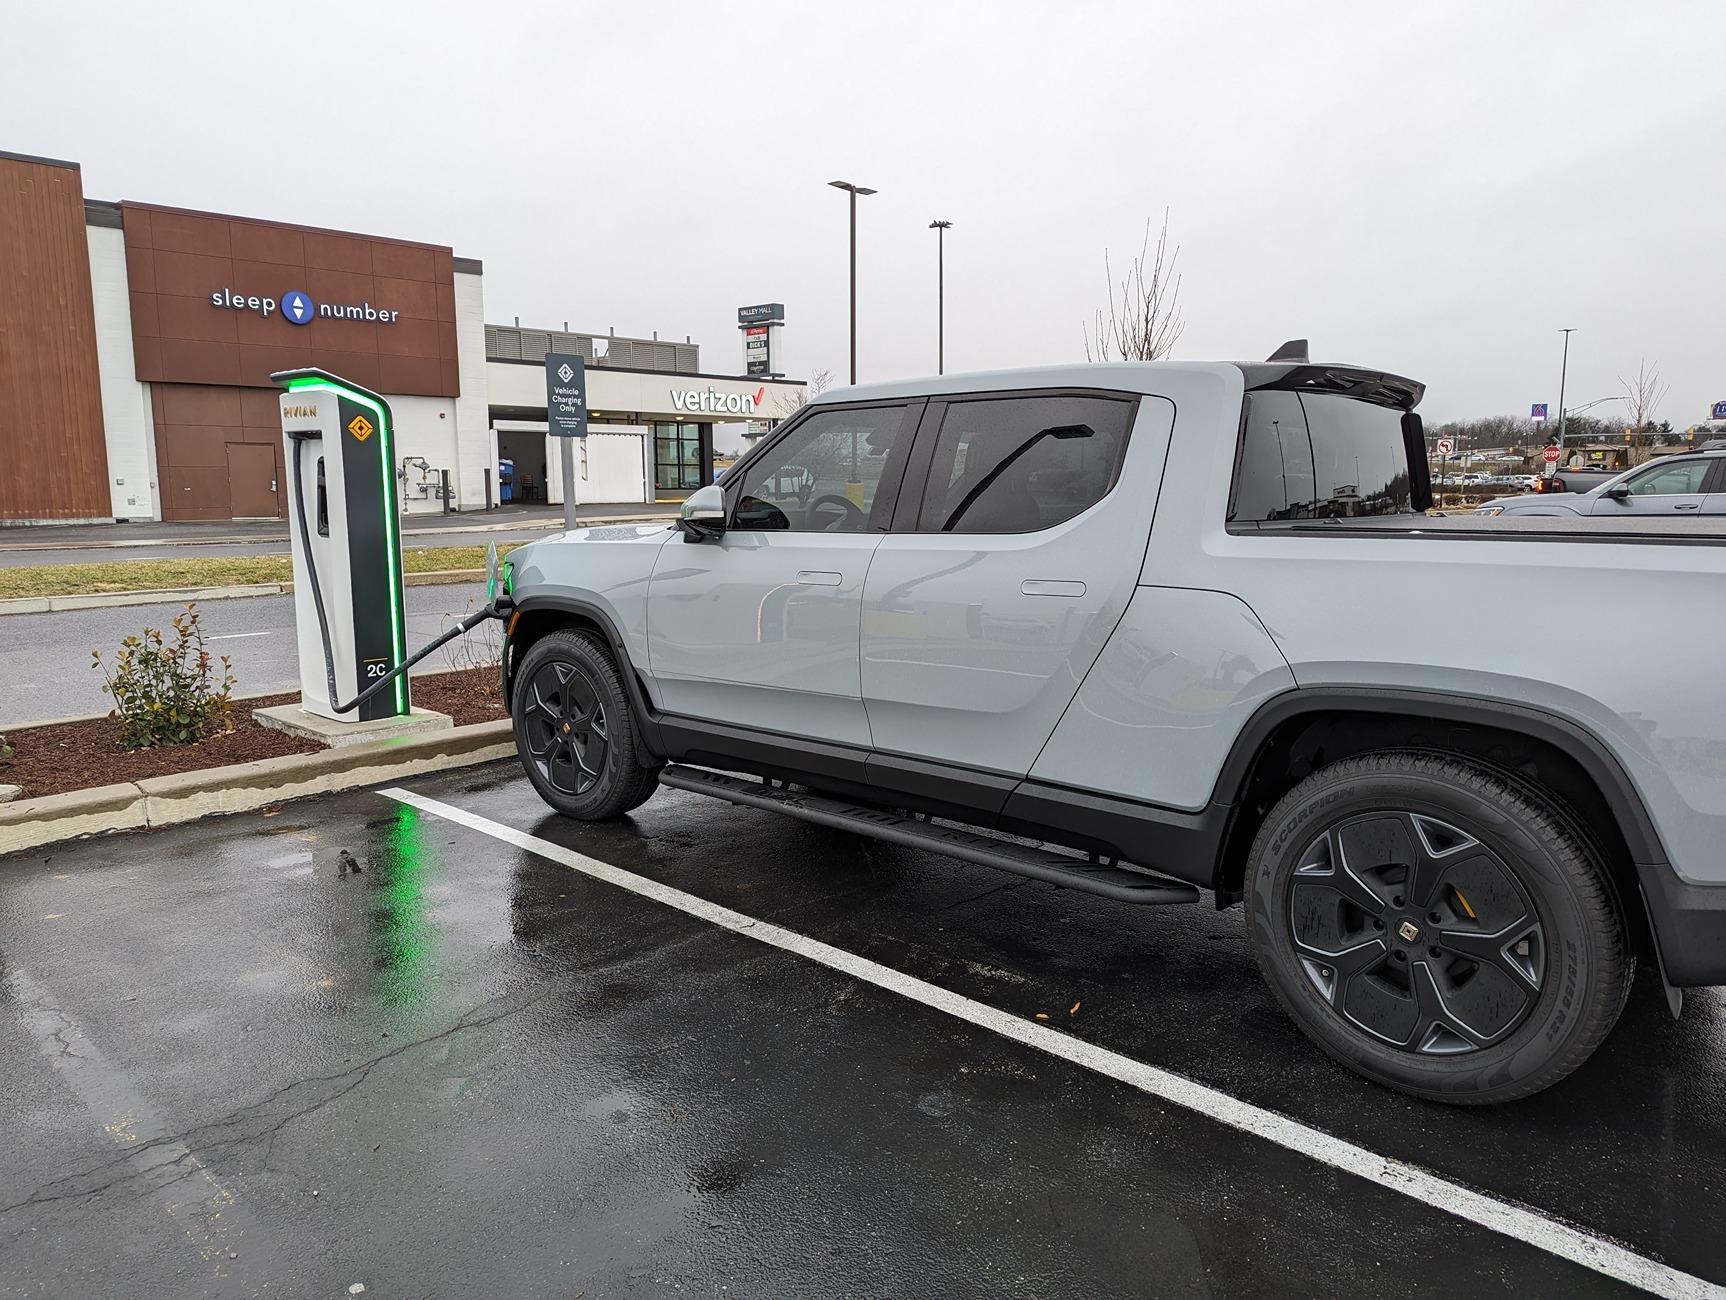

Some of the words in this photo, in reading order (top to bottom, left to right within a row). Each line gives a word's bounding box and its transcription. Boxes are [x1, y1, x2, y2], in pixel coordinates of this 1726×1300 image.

[212, 288, 276, 316] sleep
[320, 302, 399, 322] number
[740, 308, 758, 316] VALLEY
[758, 306, 772, 314] MALL
[554, 386, 579, 396] Vehicle
[552, 395, 582, 406] Charging
[670, 386, 755, 414] verizon
[283, 405, 317, 418] RIVIAN
[559, 404, 576, 413] Only
[1544, 450, 1560, 458] STOP
[367, 663, 386, 677] 2C
[1272, 786, 1355, 856] SCORPION
